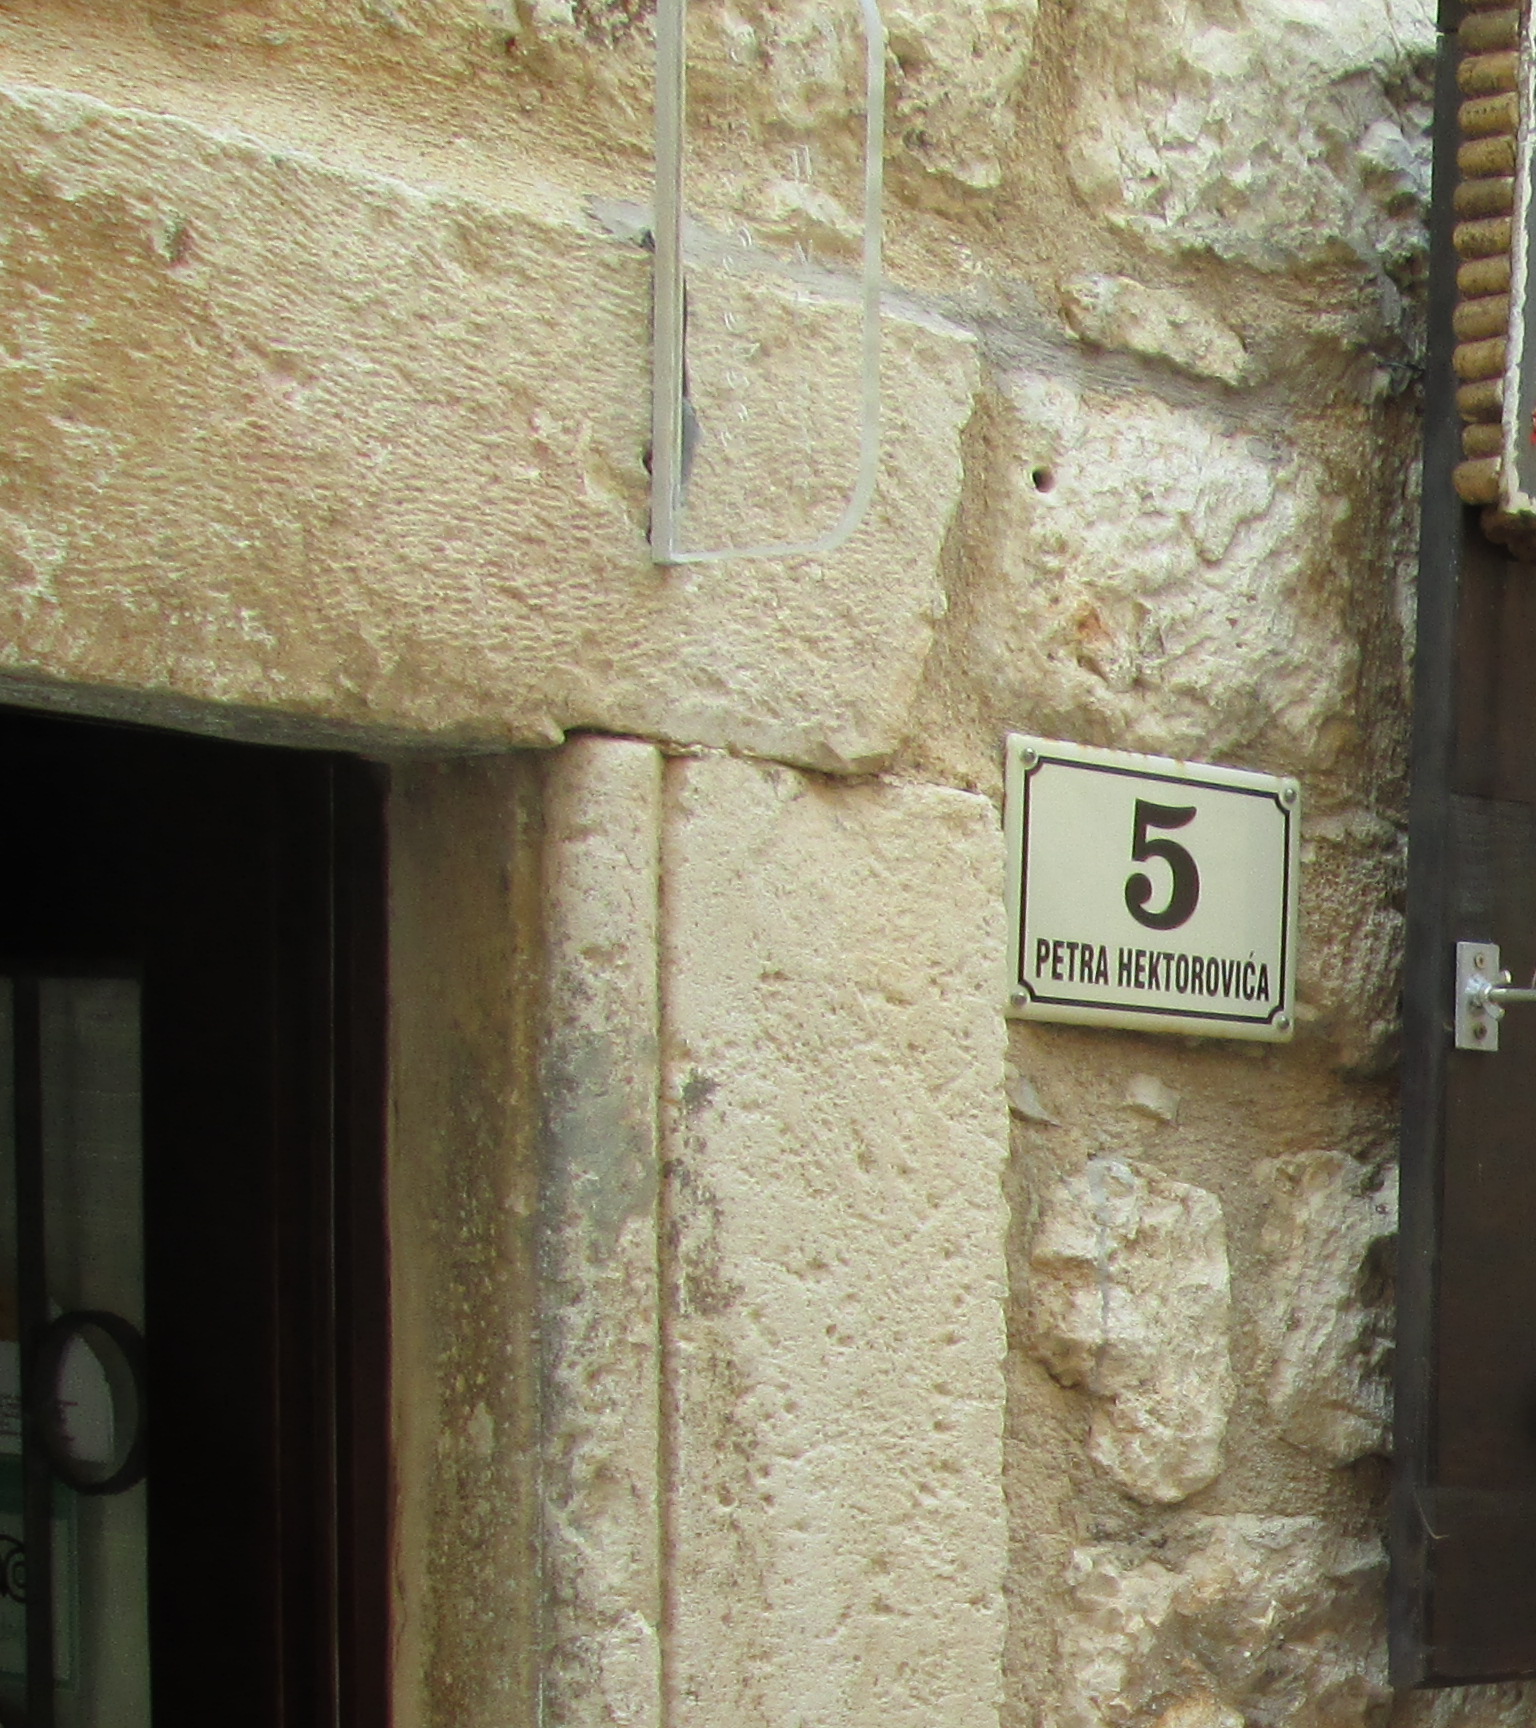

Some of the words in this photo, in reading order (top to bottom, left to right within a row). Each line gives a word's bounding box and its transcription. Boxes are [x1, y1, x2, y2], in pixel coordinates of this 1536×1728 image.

[1124, 798, 1200, 931] 5
[1035, 937, 1109, 986] PETRA
[1117, 948, 1270, 1002] HEKTOROVIĆA
